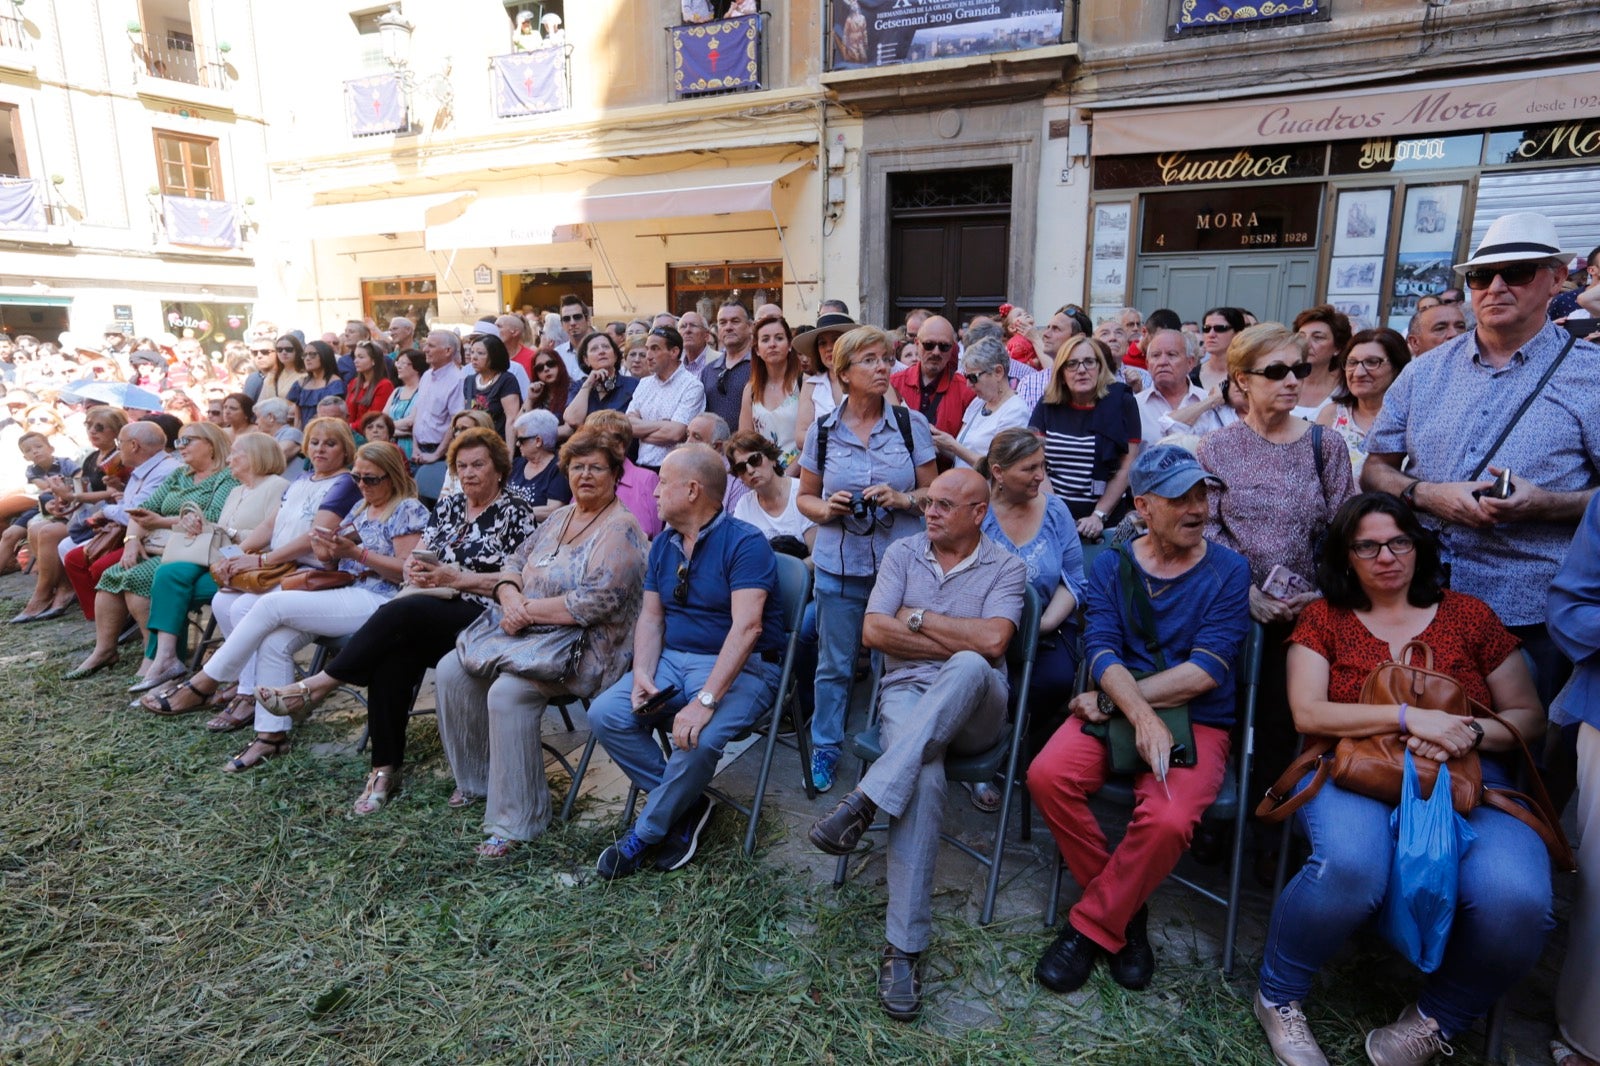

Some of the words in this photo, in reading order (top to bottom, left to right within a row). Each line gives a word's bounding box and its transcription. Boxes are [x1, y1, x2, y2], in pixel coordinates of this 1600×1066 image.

[874, 12, 928, 30] Getsemaní
[930, 12, 953, 23] 2019
[955, 4, 1001, 19] Granada
[1257, 106, 1385, 137] Cuadros
[1392, 91, 1497, 125] Mora
[1526, 101, 1566, 114] desde
[1572, 95, 1600, 109] 192
[1157, 147, 1291, 186] Cuadros
[1196, 212, 1259, 229] MORA
[1156, 234, 1165, 246] 4
[1241, 234, 1278, 244] DESDE
